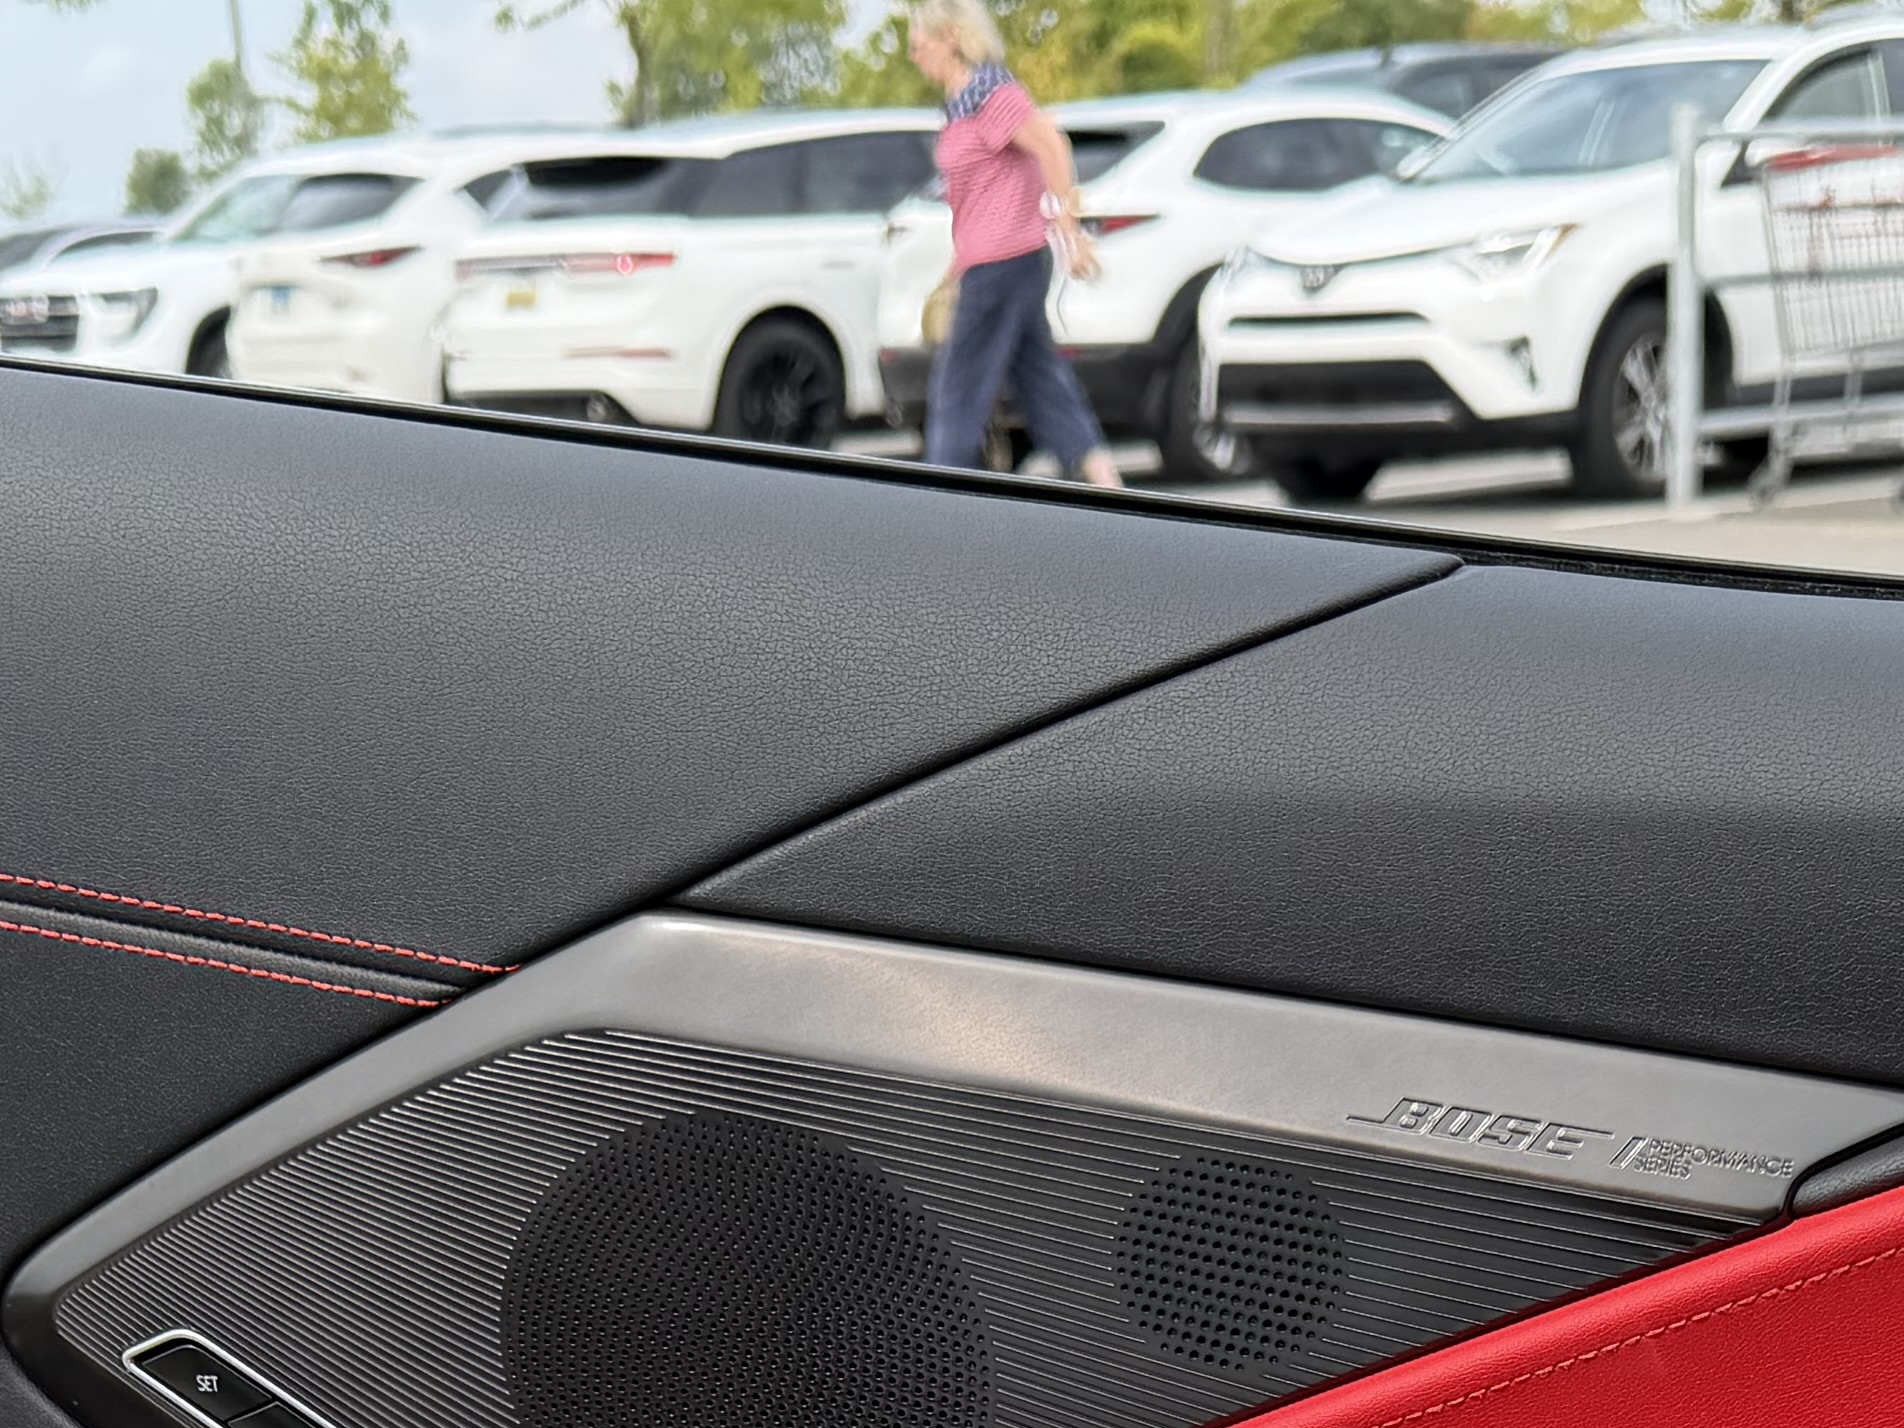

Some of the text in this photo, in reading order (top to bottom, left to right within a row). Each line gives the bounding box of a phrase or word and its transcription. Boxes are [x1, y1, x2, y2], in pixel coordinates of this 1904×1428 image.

[1346, 1096, 1615, 1161] BOSE
[1633, 1154, 1692, 1180] SERIES
[1648, 1137, 1795, 1179] PERFORMANCE
[196, 1374, 218, 1392] SET
